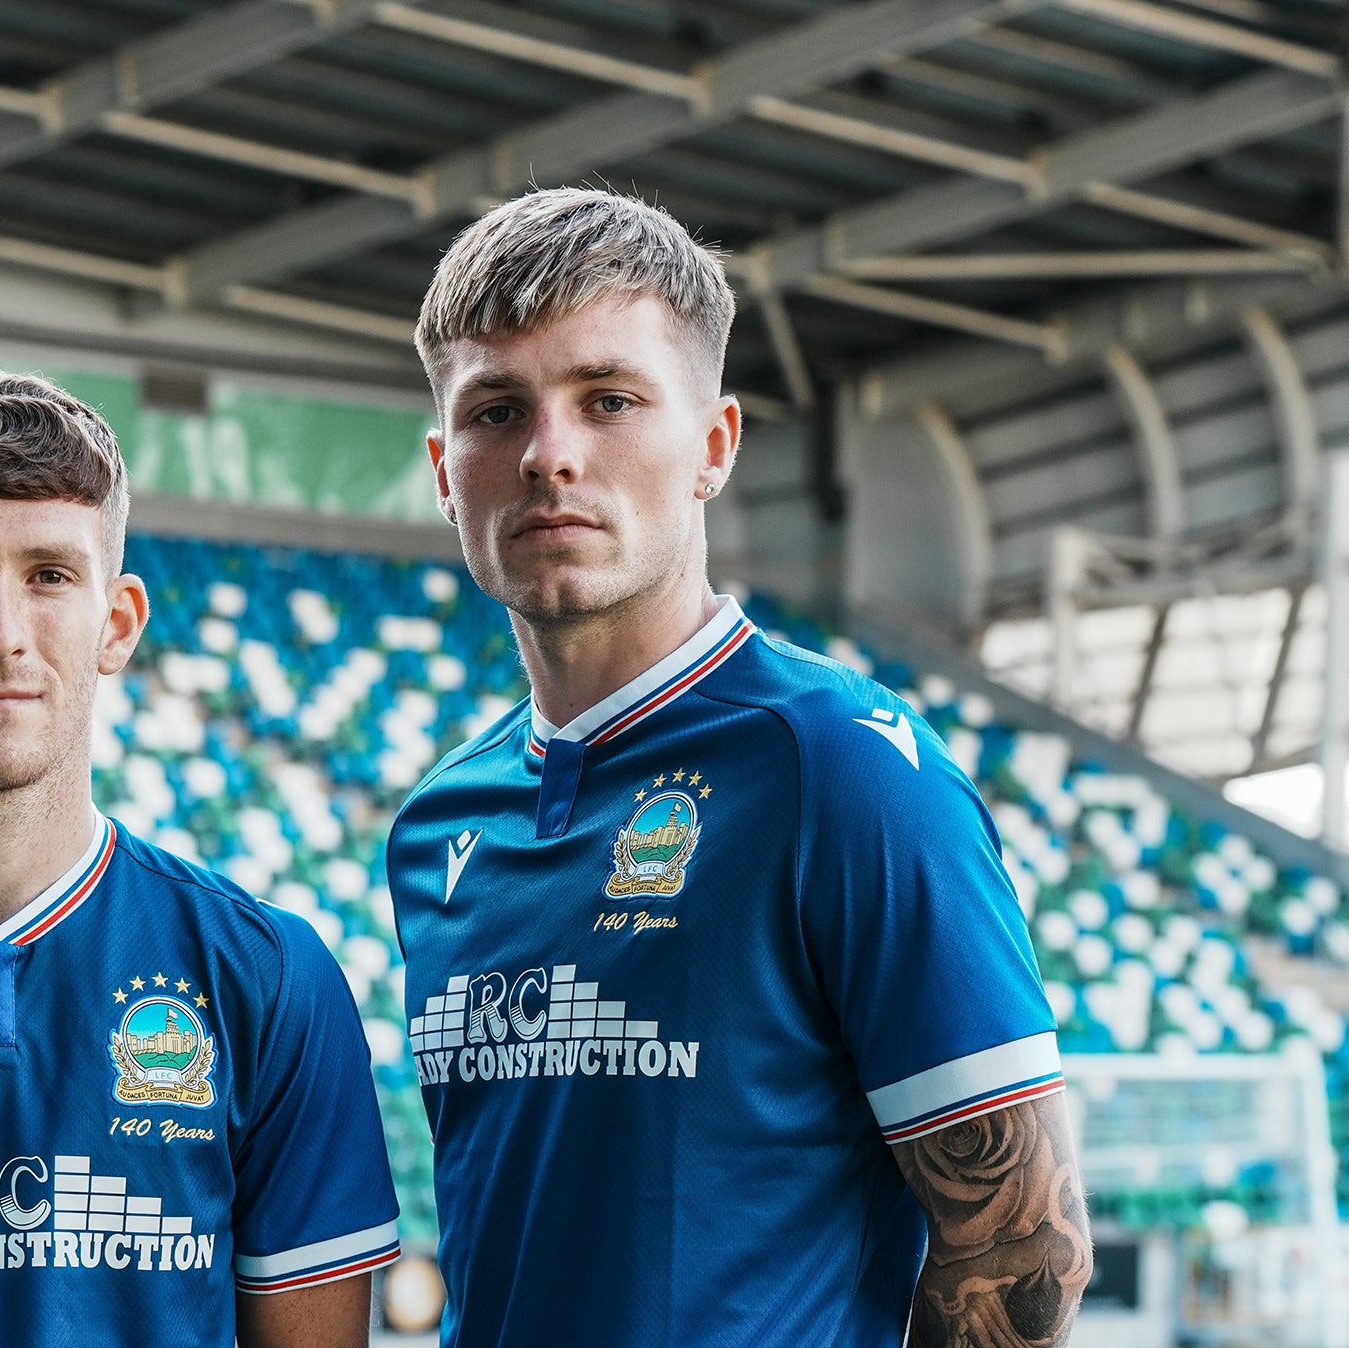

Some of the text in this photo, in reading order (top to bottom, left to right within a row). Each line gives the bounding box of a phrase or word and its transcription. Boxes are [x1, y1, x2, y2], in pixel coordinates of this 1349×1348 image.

[643, 865, 658, 873] LFC
[593, 911, 678, 935] 140 Years
[467, 967, 547, 1044] RC
[414, 1039, 699, 1087] ADY CONSTRUCTION
[118, 1088, 204, 1102] AUDACES FORTUNA JUVAT
[109, 1117, 215, 1143] 140 Years
